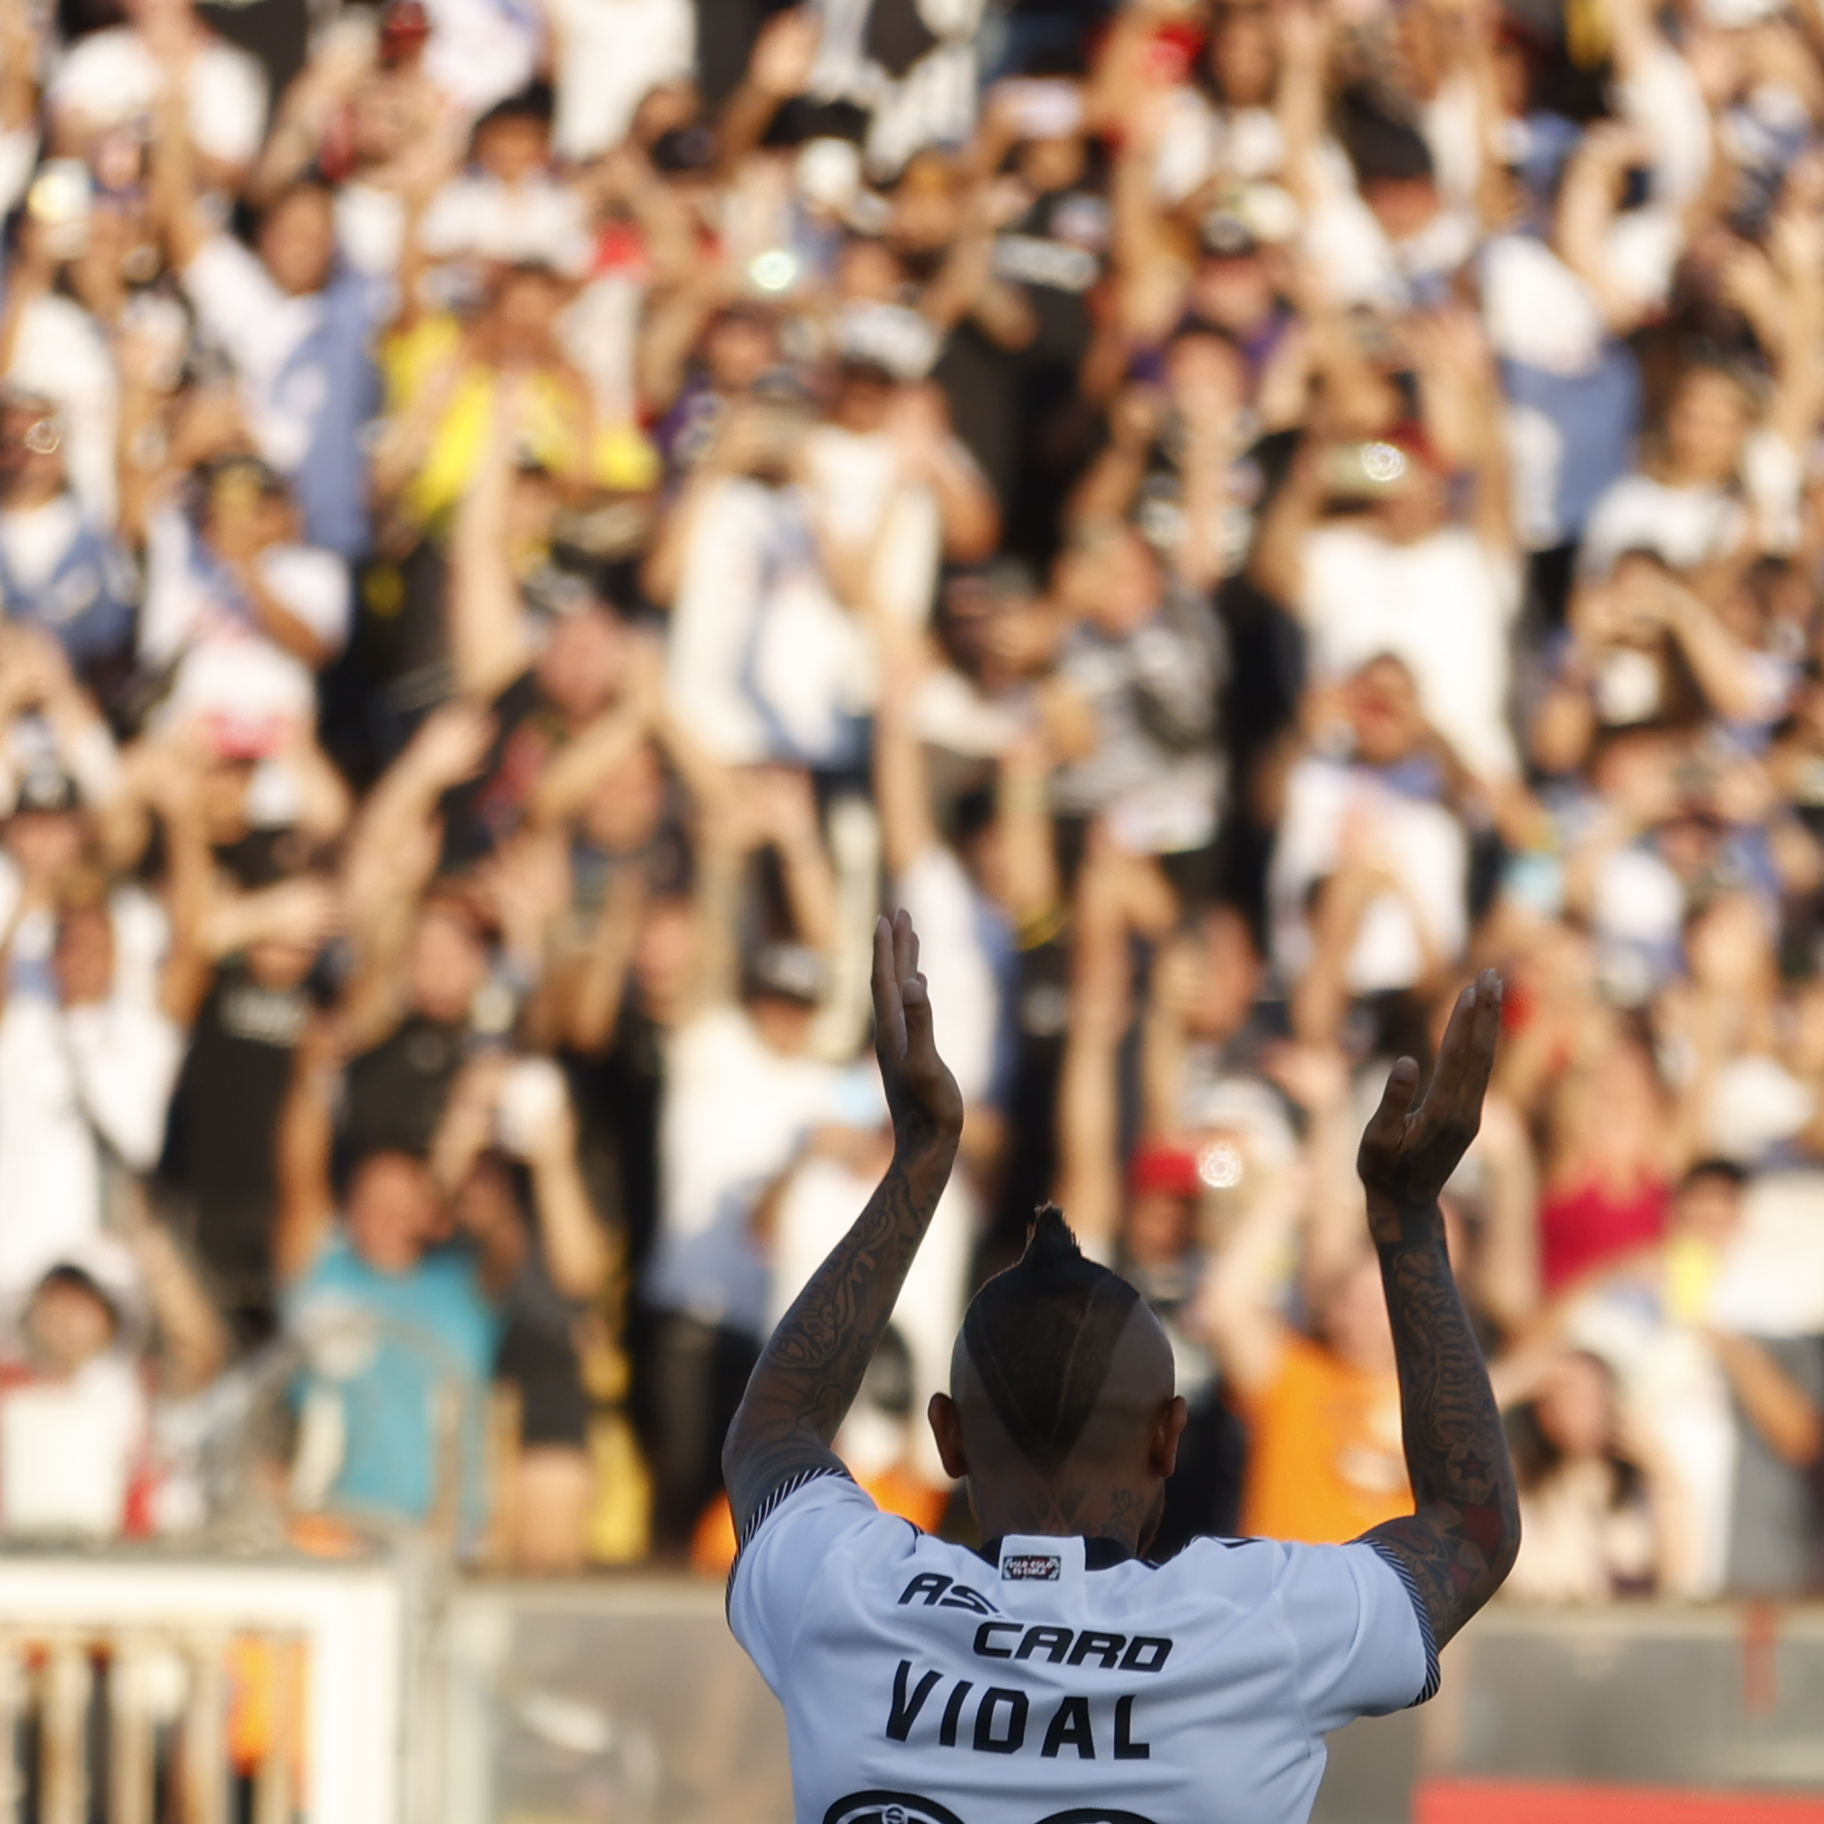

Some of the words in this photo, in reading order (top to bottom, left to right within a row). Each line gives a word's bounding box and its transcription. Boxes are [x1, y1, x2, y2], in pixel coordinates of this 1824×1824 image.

[897, 1572, 1004, 1618] AS
[973, 1621, 1173, 1673] CARD
[886, 1659, 1150, 1760] VIDAL
